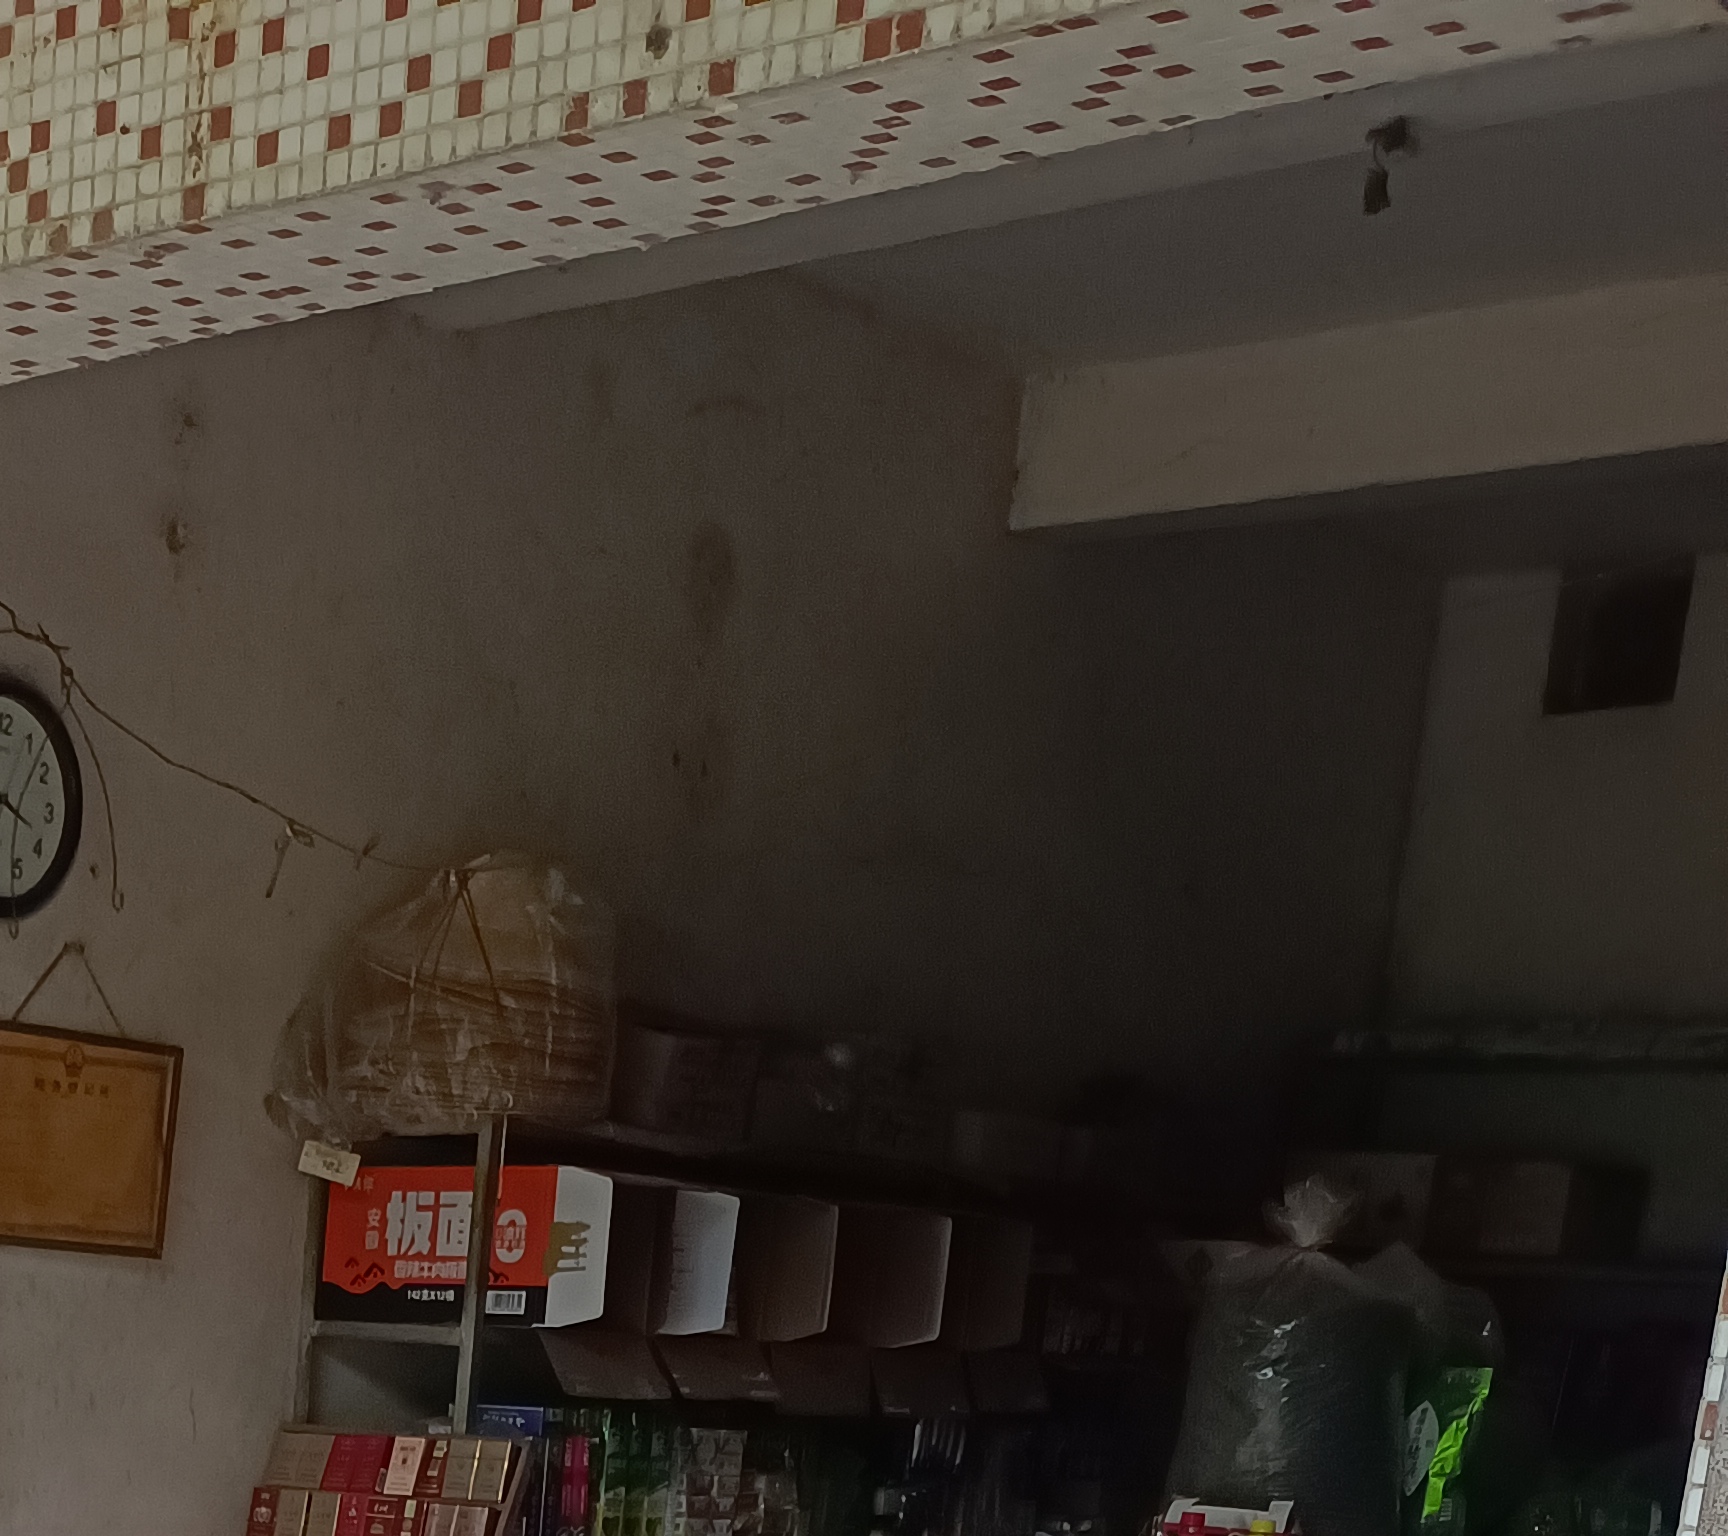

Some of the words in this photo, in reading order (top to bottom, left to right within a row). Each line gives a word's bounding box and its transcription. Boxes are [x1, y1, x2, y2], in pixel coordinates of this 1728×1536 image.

[39, 762, 50, 785] 2
[43, 802, 54, 824] 3
[32, 838, 43, 860] 4
[385, 1190, 474, 1257] 板面
